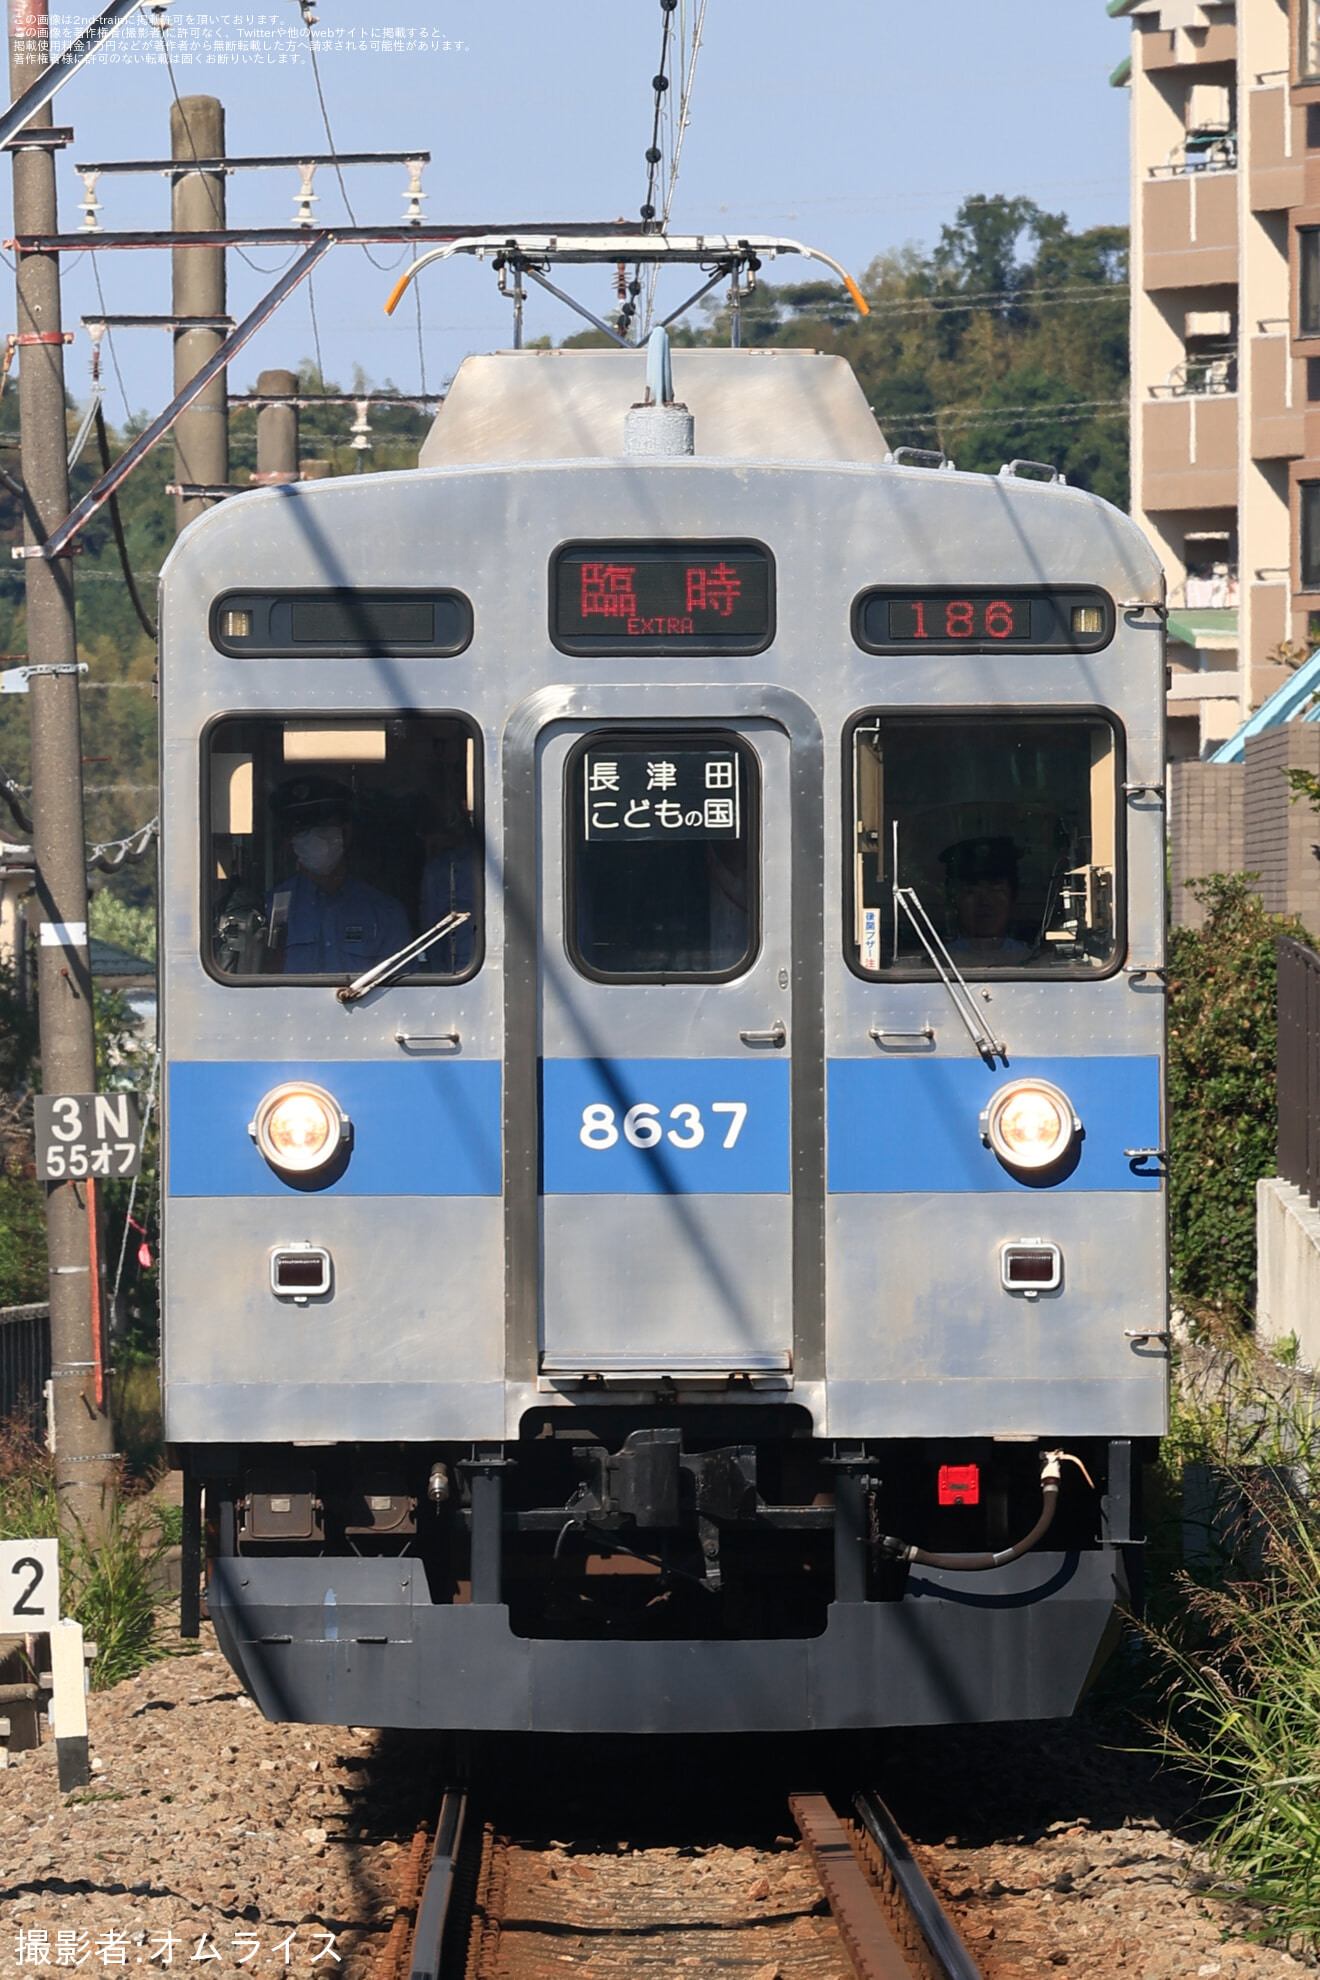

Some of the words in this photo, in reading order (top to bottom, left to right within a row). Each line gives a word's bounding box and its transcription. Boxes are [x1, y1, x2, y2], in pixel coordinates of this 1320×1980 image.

[581, 562, 741, 617] 臨時
[627, 617, 694, 635] EXTRA
[911, 601, 1014, 638] 186
[589, 761, 733, 791] 長津田
[592, 798, 733, 829] こどもの国
[579, 1102, 748, 1150] 8637
[11, 1557, 45, 1615] 2
